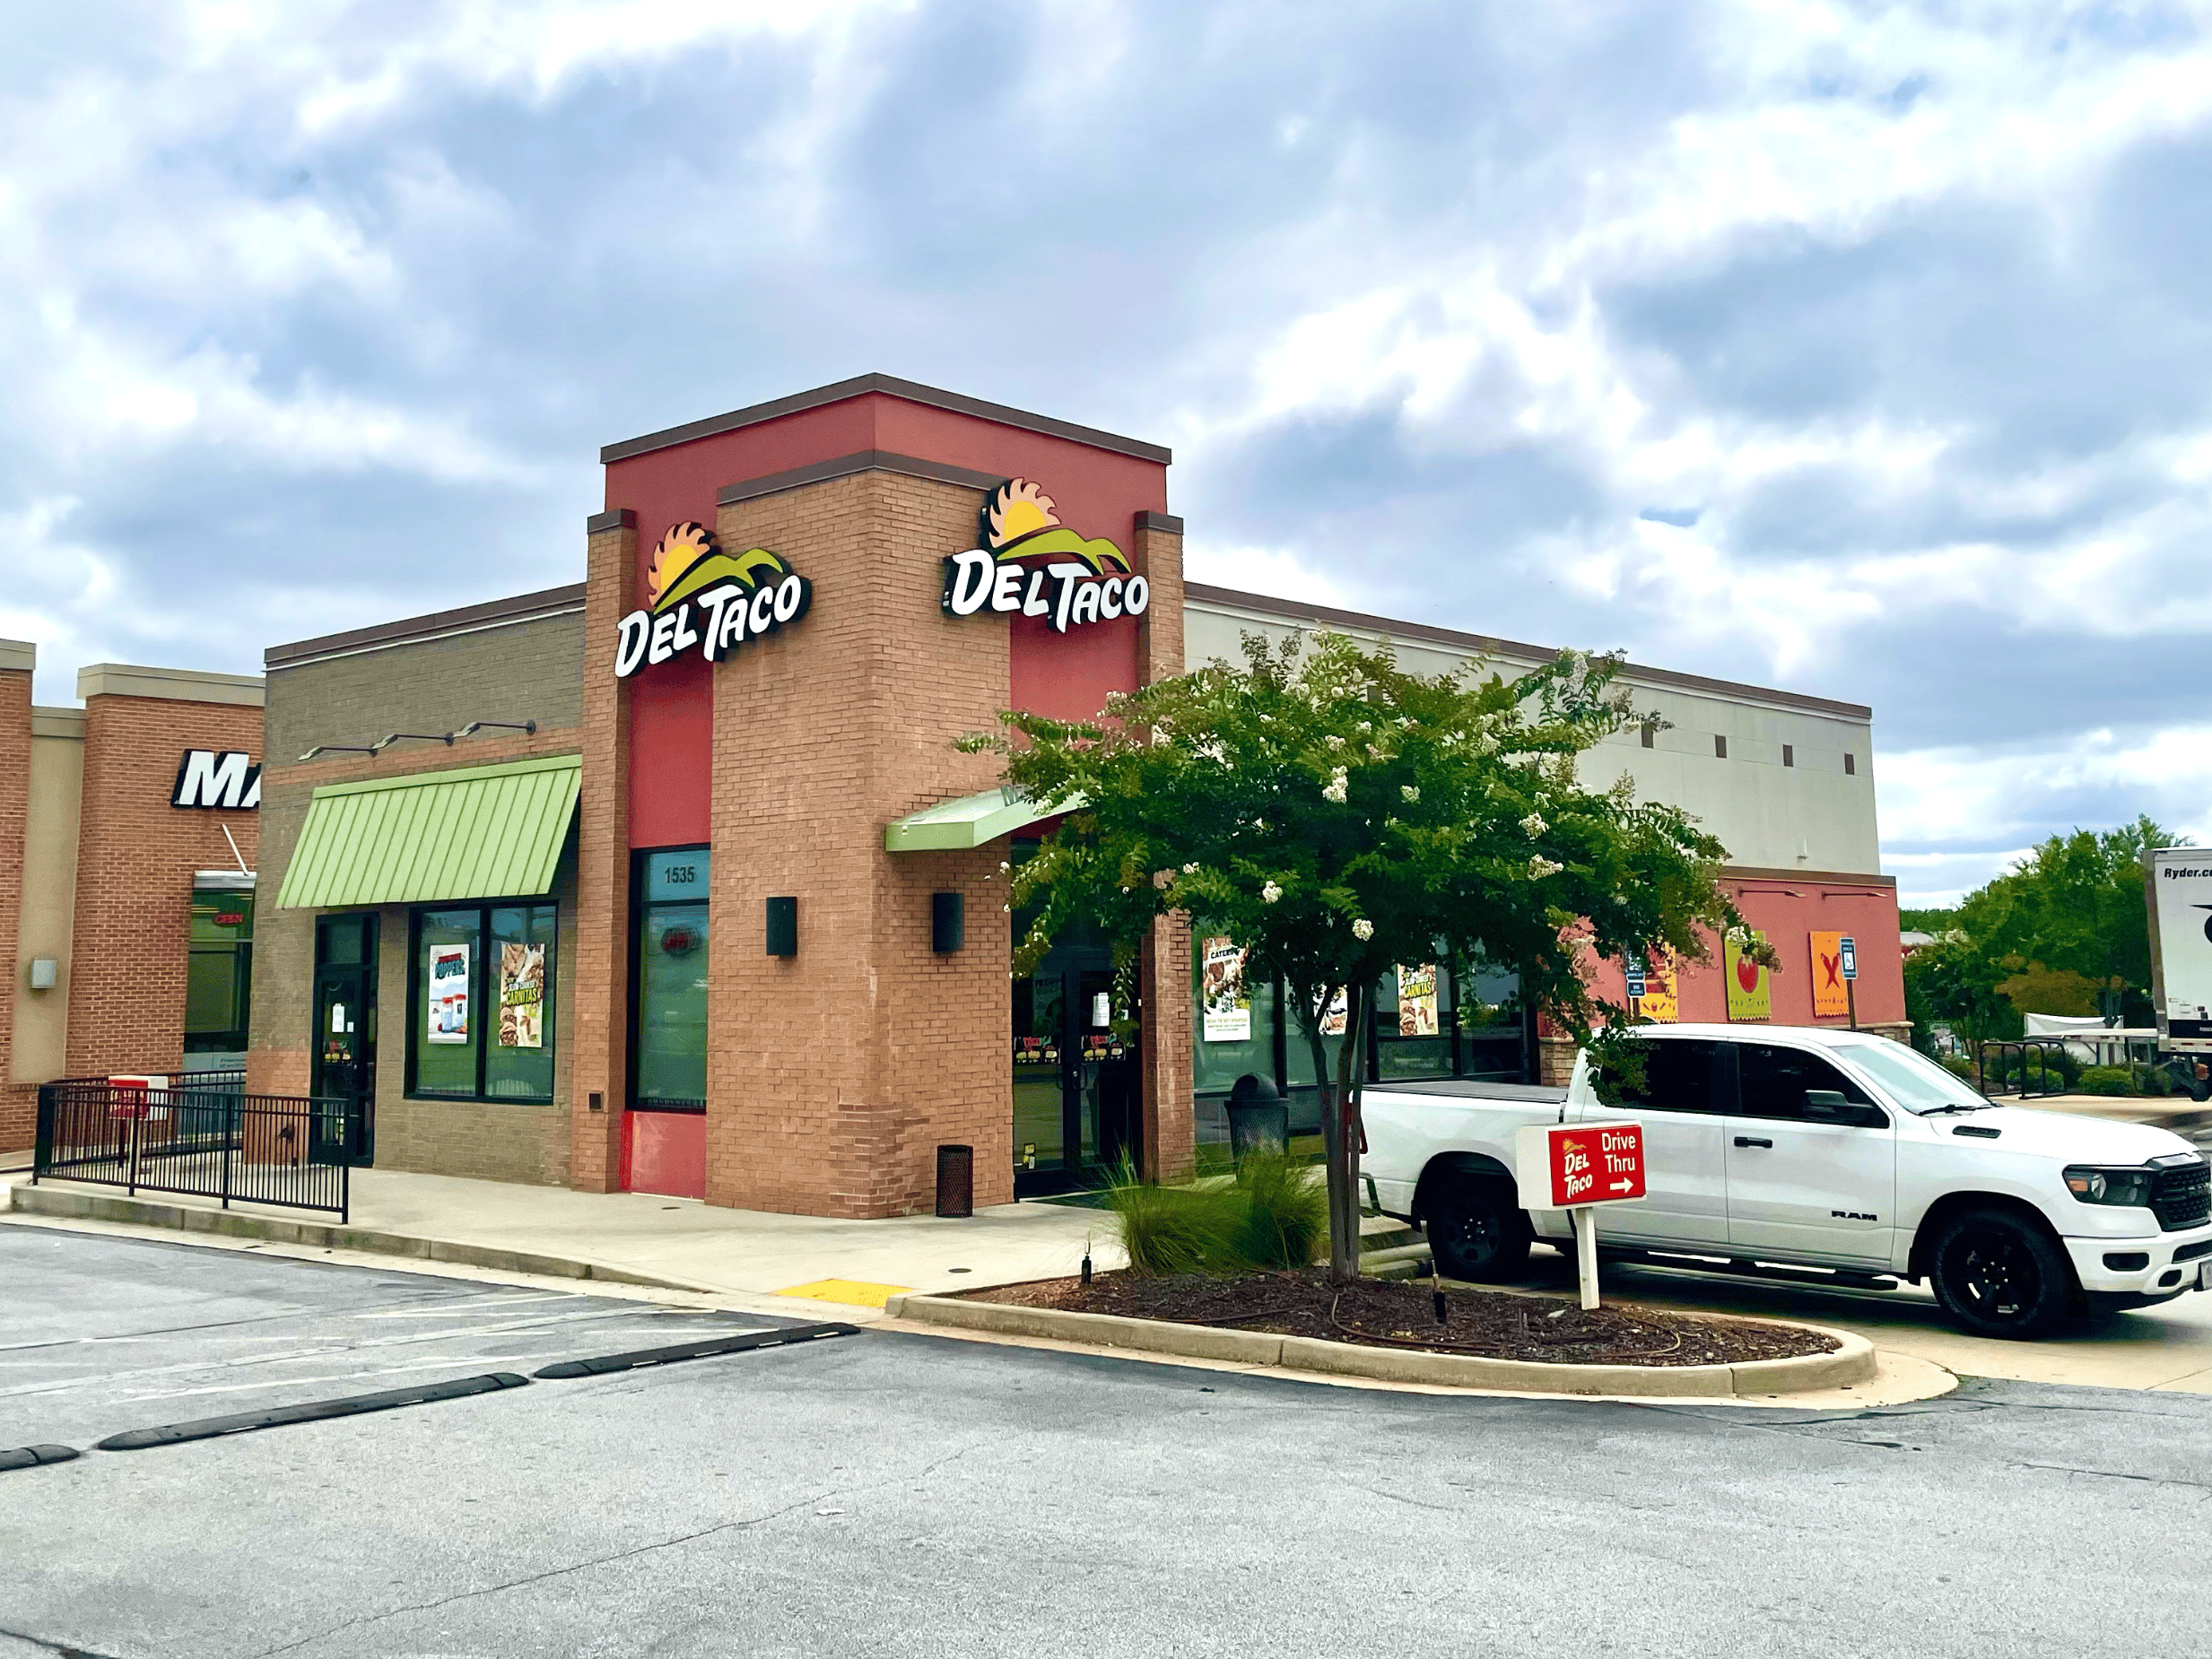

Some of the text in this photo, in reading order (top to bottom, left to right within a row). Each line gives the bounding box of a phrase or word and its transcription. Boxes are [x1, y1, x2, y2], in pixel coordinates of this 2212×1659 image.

[951, 549, 1149, 633] DEL TACO
[614, 575, 802, 678] DEL TACO
[665, 866, 694, 883] 1535
[2164, 867, 2212, 880] Ryder.c
[435, 959, 466, 979] POPPERS
[507, 987, 537, 1004] CARNITAS
[1601, 1132, 1636, 1151] Drive
[1564, 1152, 1589, 1175] DEL
[1605, 1154, 1635, 1173] Thru
[1563, 1174, 1593, 1199] TACO
[1832, 1211, 1877, 1221] RAM
